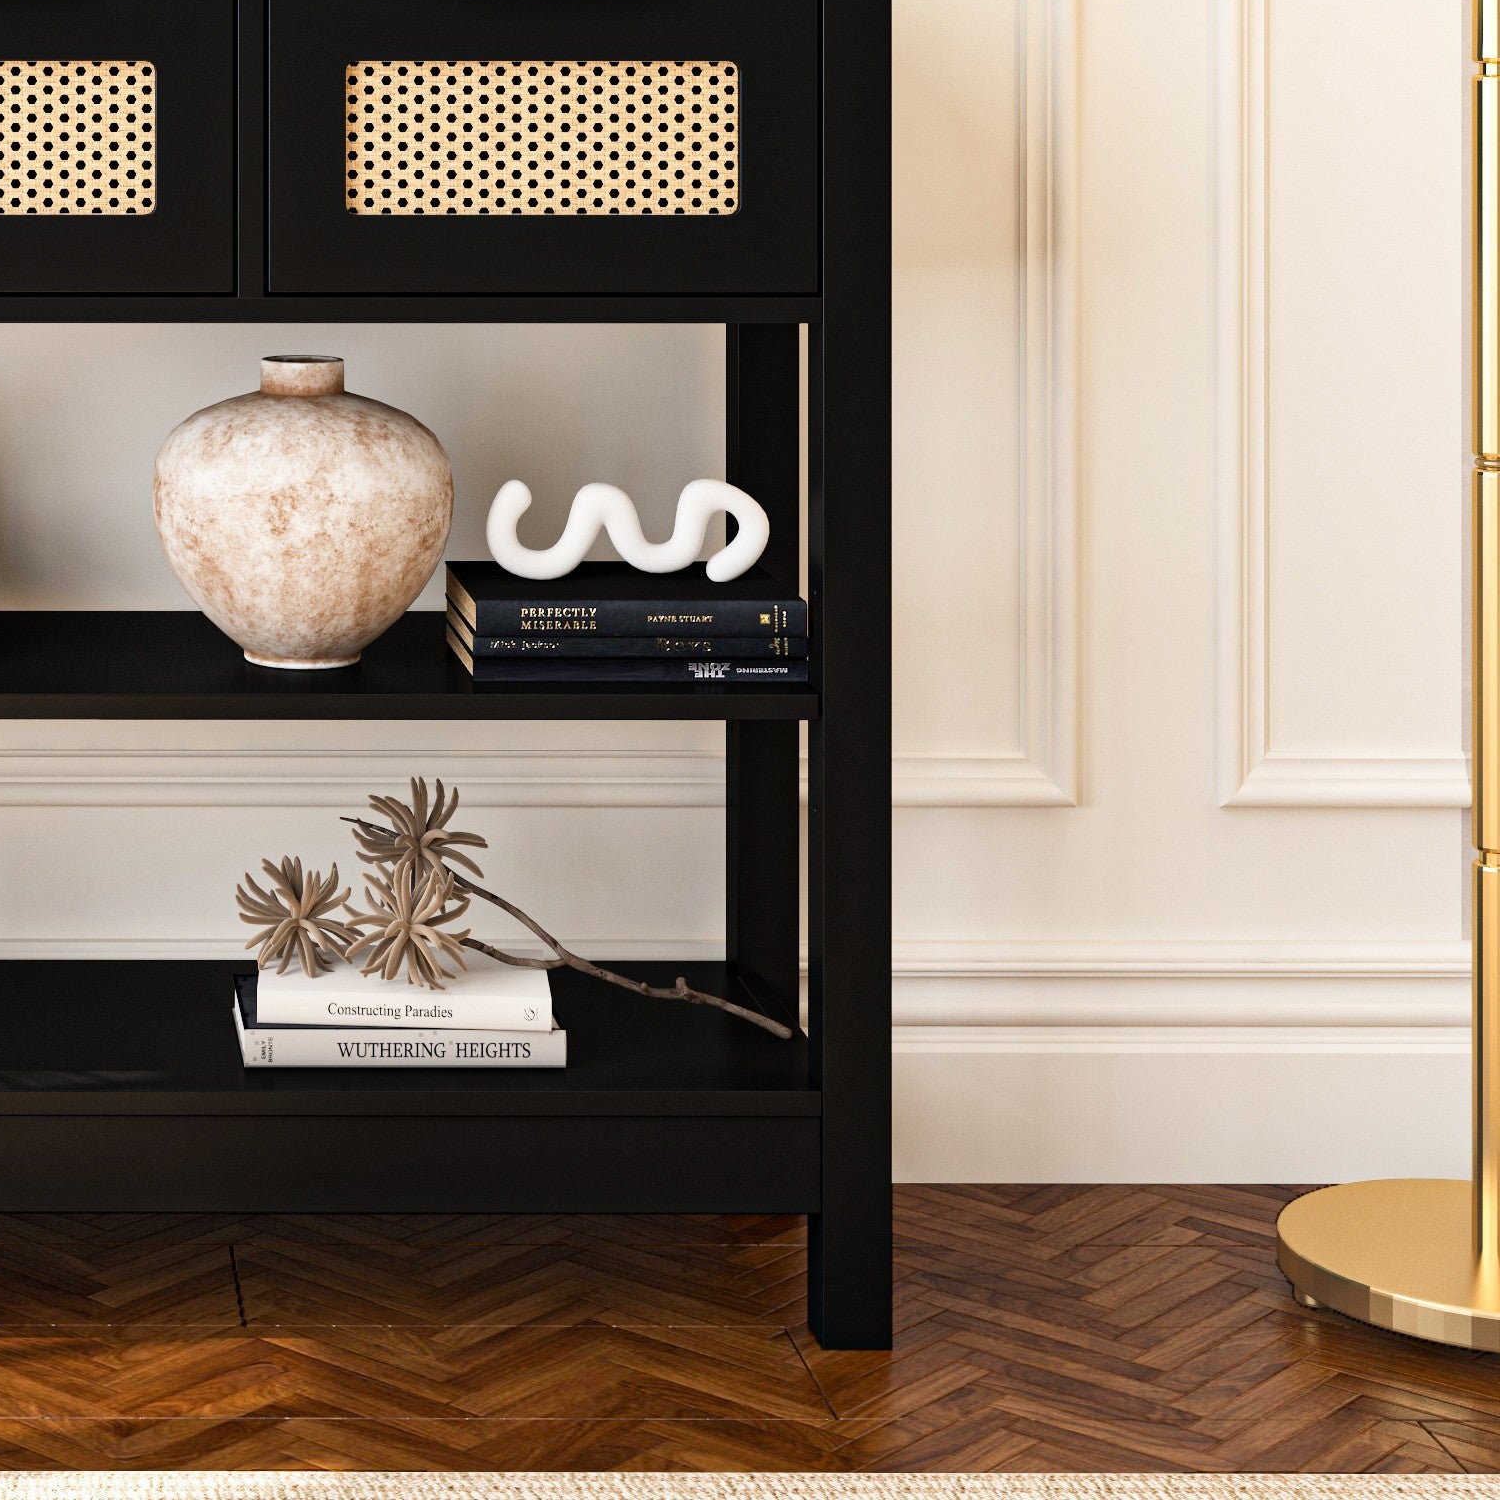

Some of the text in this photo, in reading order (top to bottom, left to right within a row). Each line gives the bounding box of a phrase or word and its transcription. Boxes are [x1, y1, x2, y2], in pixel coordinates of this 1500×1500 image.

[521, 607, 597, 618] PERFECTLY
[647, 615, 713, 623] PAYNE STUART
[521, 620, 597, 630] MISERABLE
[327, 1002, 453, 1019] Constructing Paradies
[337, 1042, 531, 1058] WUTHERING HEIGHTS
